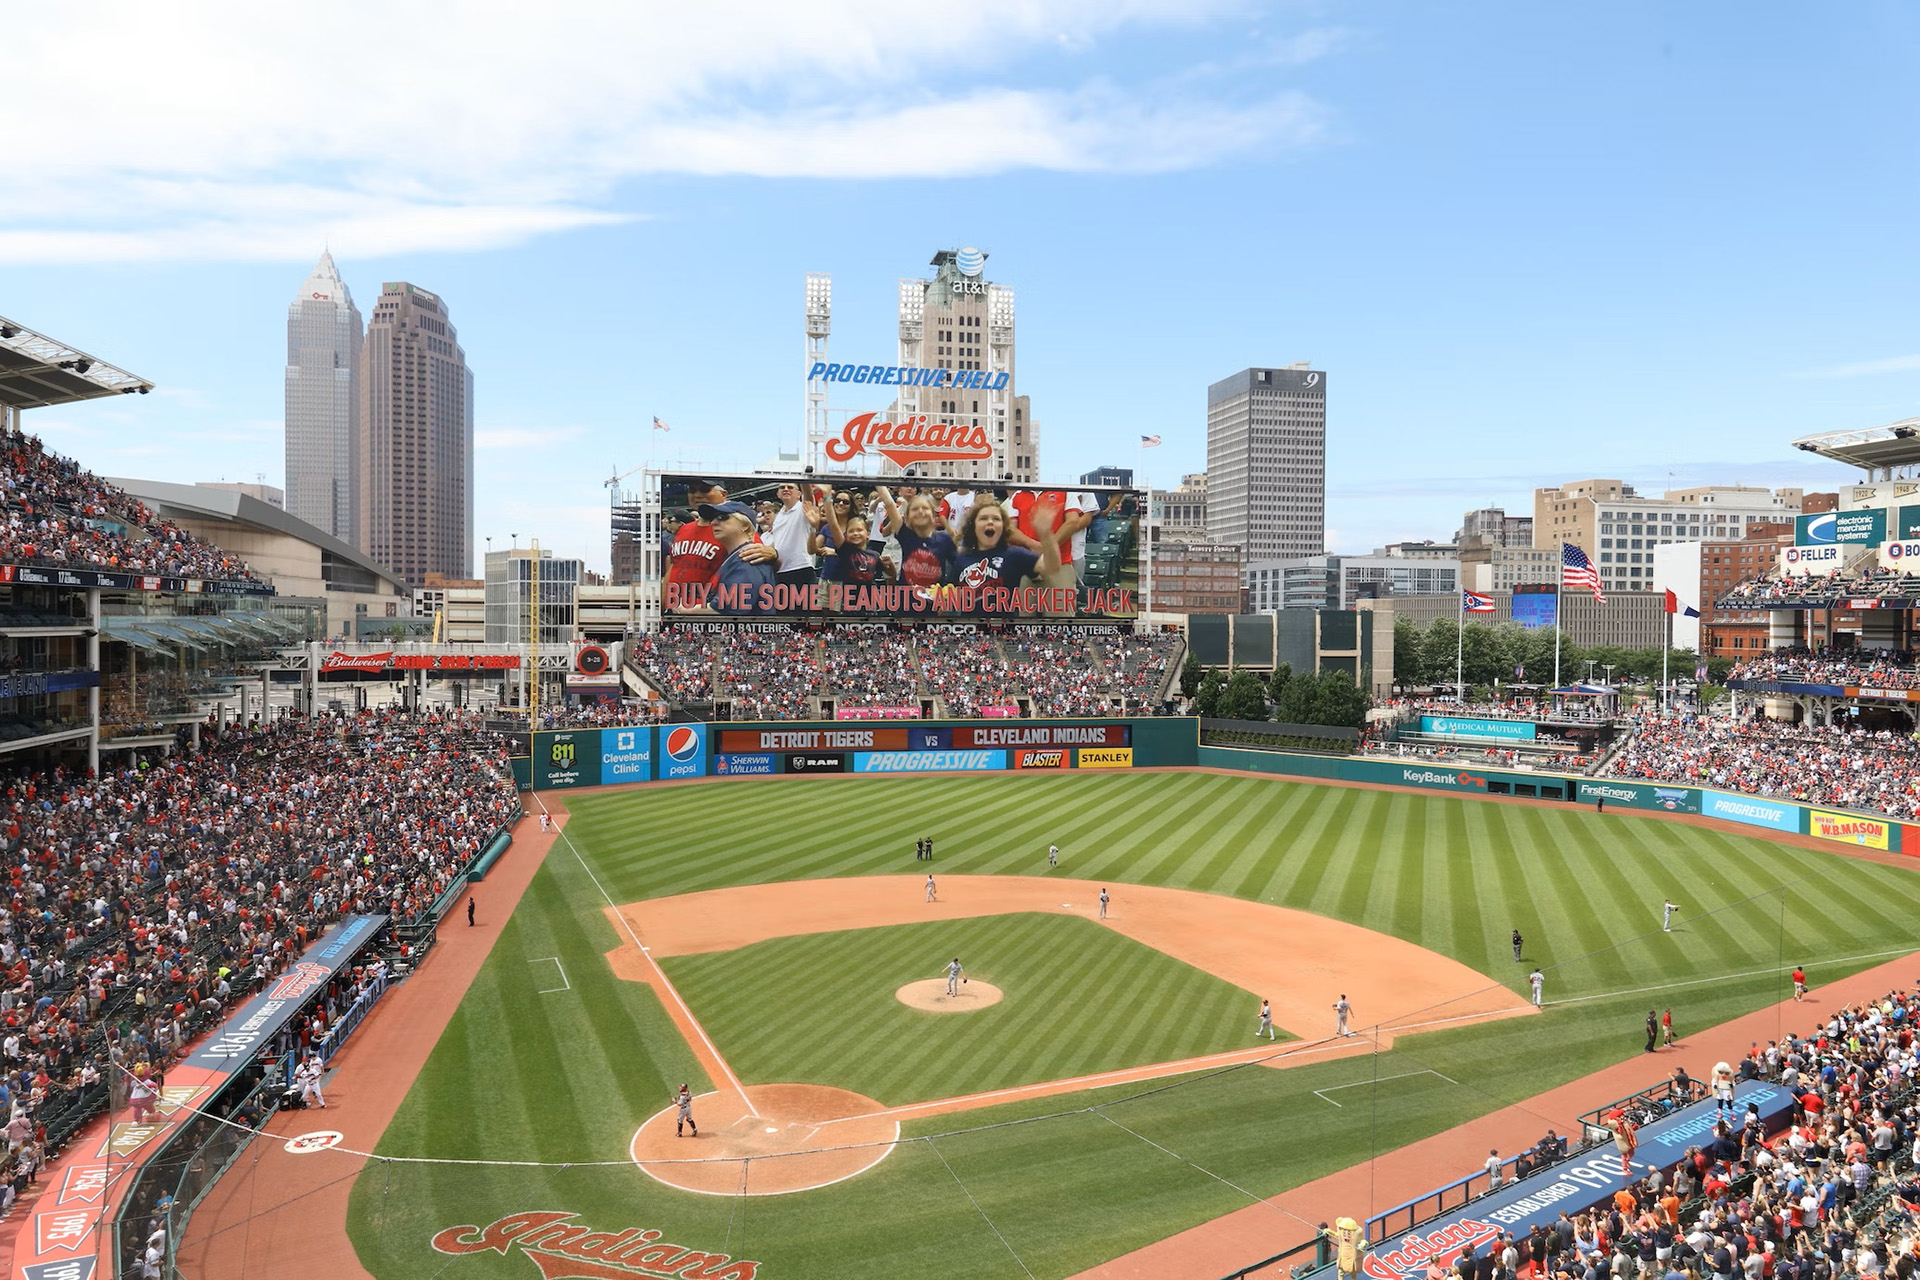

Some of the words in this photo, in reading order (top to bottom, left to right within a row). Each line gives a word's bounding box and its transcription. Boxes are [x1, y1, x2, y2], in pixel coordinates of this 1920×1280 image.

[952, 276, 988, 295] at&t
[807, 362, 950, 388] PROGRESSIVE
[950, 370, 1010, 391] FIELD
[825, 412, 993, 463] Indians
[1837, 515, 1873, 525] electronic
[1837, 523, 1872, 533] merchant
[1788, 551, 1797, 560] 19
[1800, 548, 1837, 561] FELLER
[1892, 547, 1899, 556] 5
[666, 582, 712, 610] BUY
[718, 583, 753, 610] ME
[758, 583, 822, 611] SOME
[829, 584, 927, 612] PEANUTS
[932, 586, 976, 612] AND
[981, 587, 1076, 613] CRACKER
[1083, 588, 1135, 614] JACK
[673, 623, 706, 633] START
[707, 623, 735, 633] DEAD
[1014, 625, 1044, 634] START
[1046, 625, 1069, 634] DEAD
[329, 655, 387, 668] Budweiser
[395, 655, 437, 669] HOME
[441, 655, 470, 669] RUN
[473, 655, 520, 670] PORCH
[1448, 722, 1486, 732] MEDICAL
[1487, 724, 1523, 735] MUTUAL
[760, 731, 820, 749] DETROIT
[823, 731, 874, 748] TIGERS
[925, 736, 938, 747] VS
[973, 728, 1050, 745] CLEVELAND
[1053, 727, 1106, 744] INDIANS
[552, 743, 574, 761] 811
[603, 751, 650, 764] Cleveland
[1022, 752, 1062, 767] BLASTER
[1081, 753, 1129, 763] STANLEY
[731, 756, 769, 765] SHERWIN
[865, 752, 992, 770] PROGRESSIVE
[613, 763, 640, 775] Clinic
[669, 764, 697, 776] pepsi
[1403, 769, 1456, 784] KeyBank
[1581, 784, 1637, 800] FirstEnergy
[1714, 800, 1785, 822] PROGRESSIVE
[200, 1030, 261, 1058] 1901
[112, 1125, 155, 1146] 1948
[71, 1167, 114, 1191] 1954
[1363, 1217, 1506, 1280] Indians
[1489, 1181, 1581, 1224] ESTABLISHED
[1559, 1153, 1645, 1188] 1901
[46, 1212, 89, 1240] 1995
[430, 1210, 763, 1280] Indians
